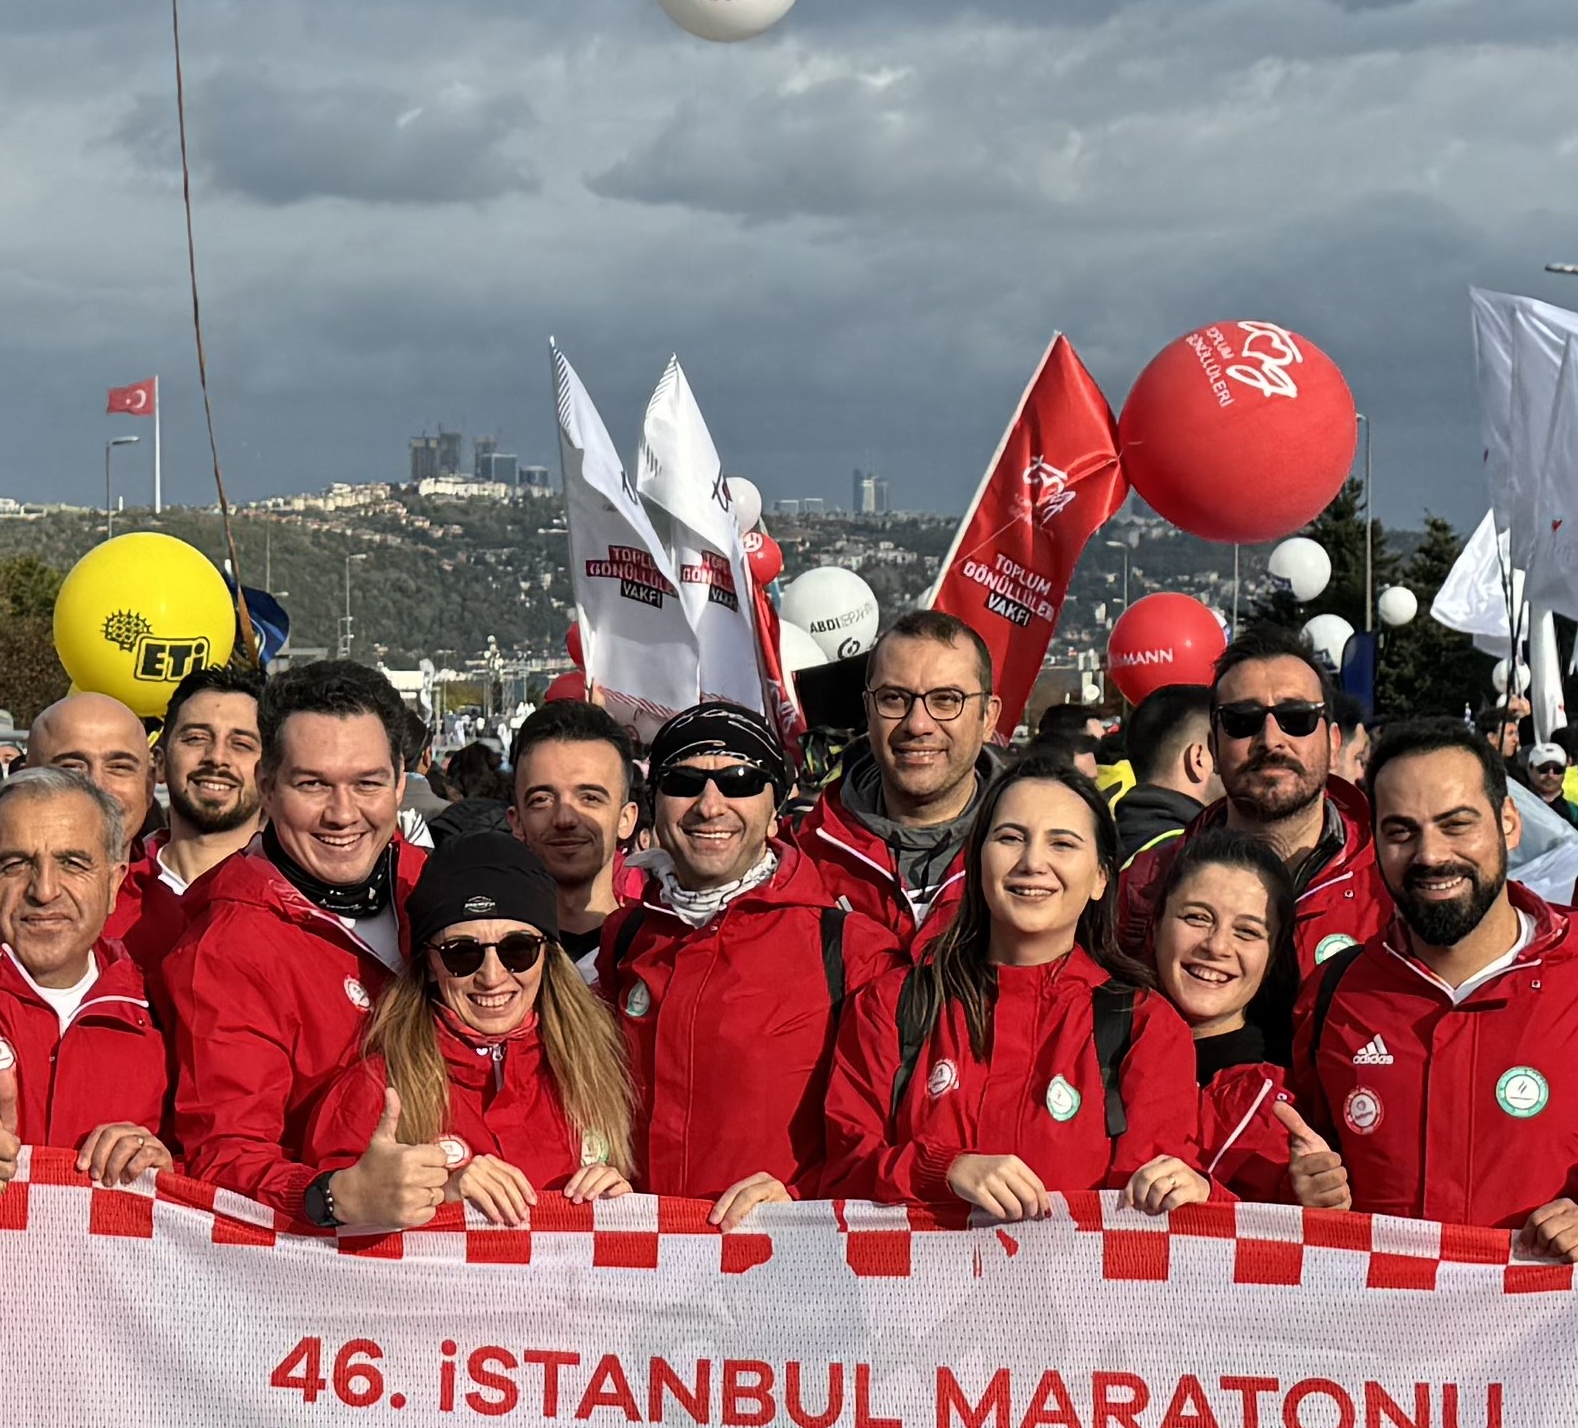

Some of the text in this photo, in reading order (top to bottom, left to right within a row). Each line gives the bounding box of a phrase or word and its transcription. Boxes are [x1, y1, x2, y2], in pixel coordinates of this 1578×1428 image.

[995, 553, 1052, 596] TOPLUM
[988, 593, 1030, 626] VAKFI
[270, 1335, 406, 1410] 46.
